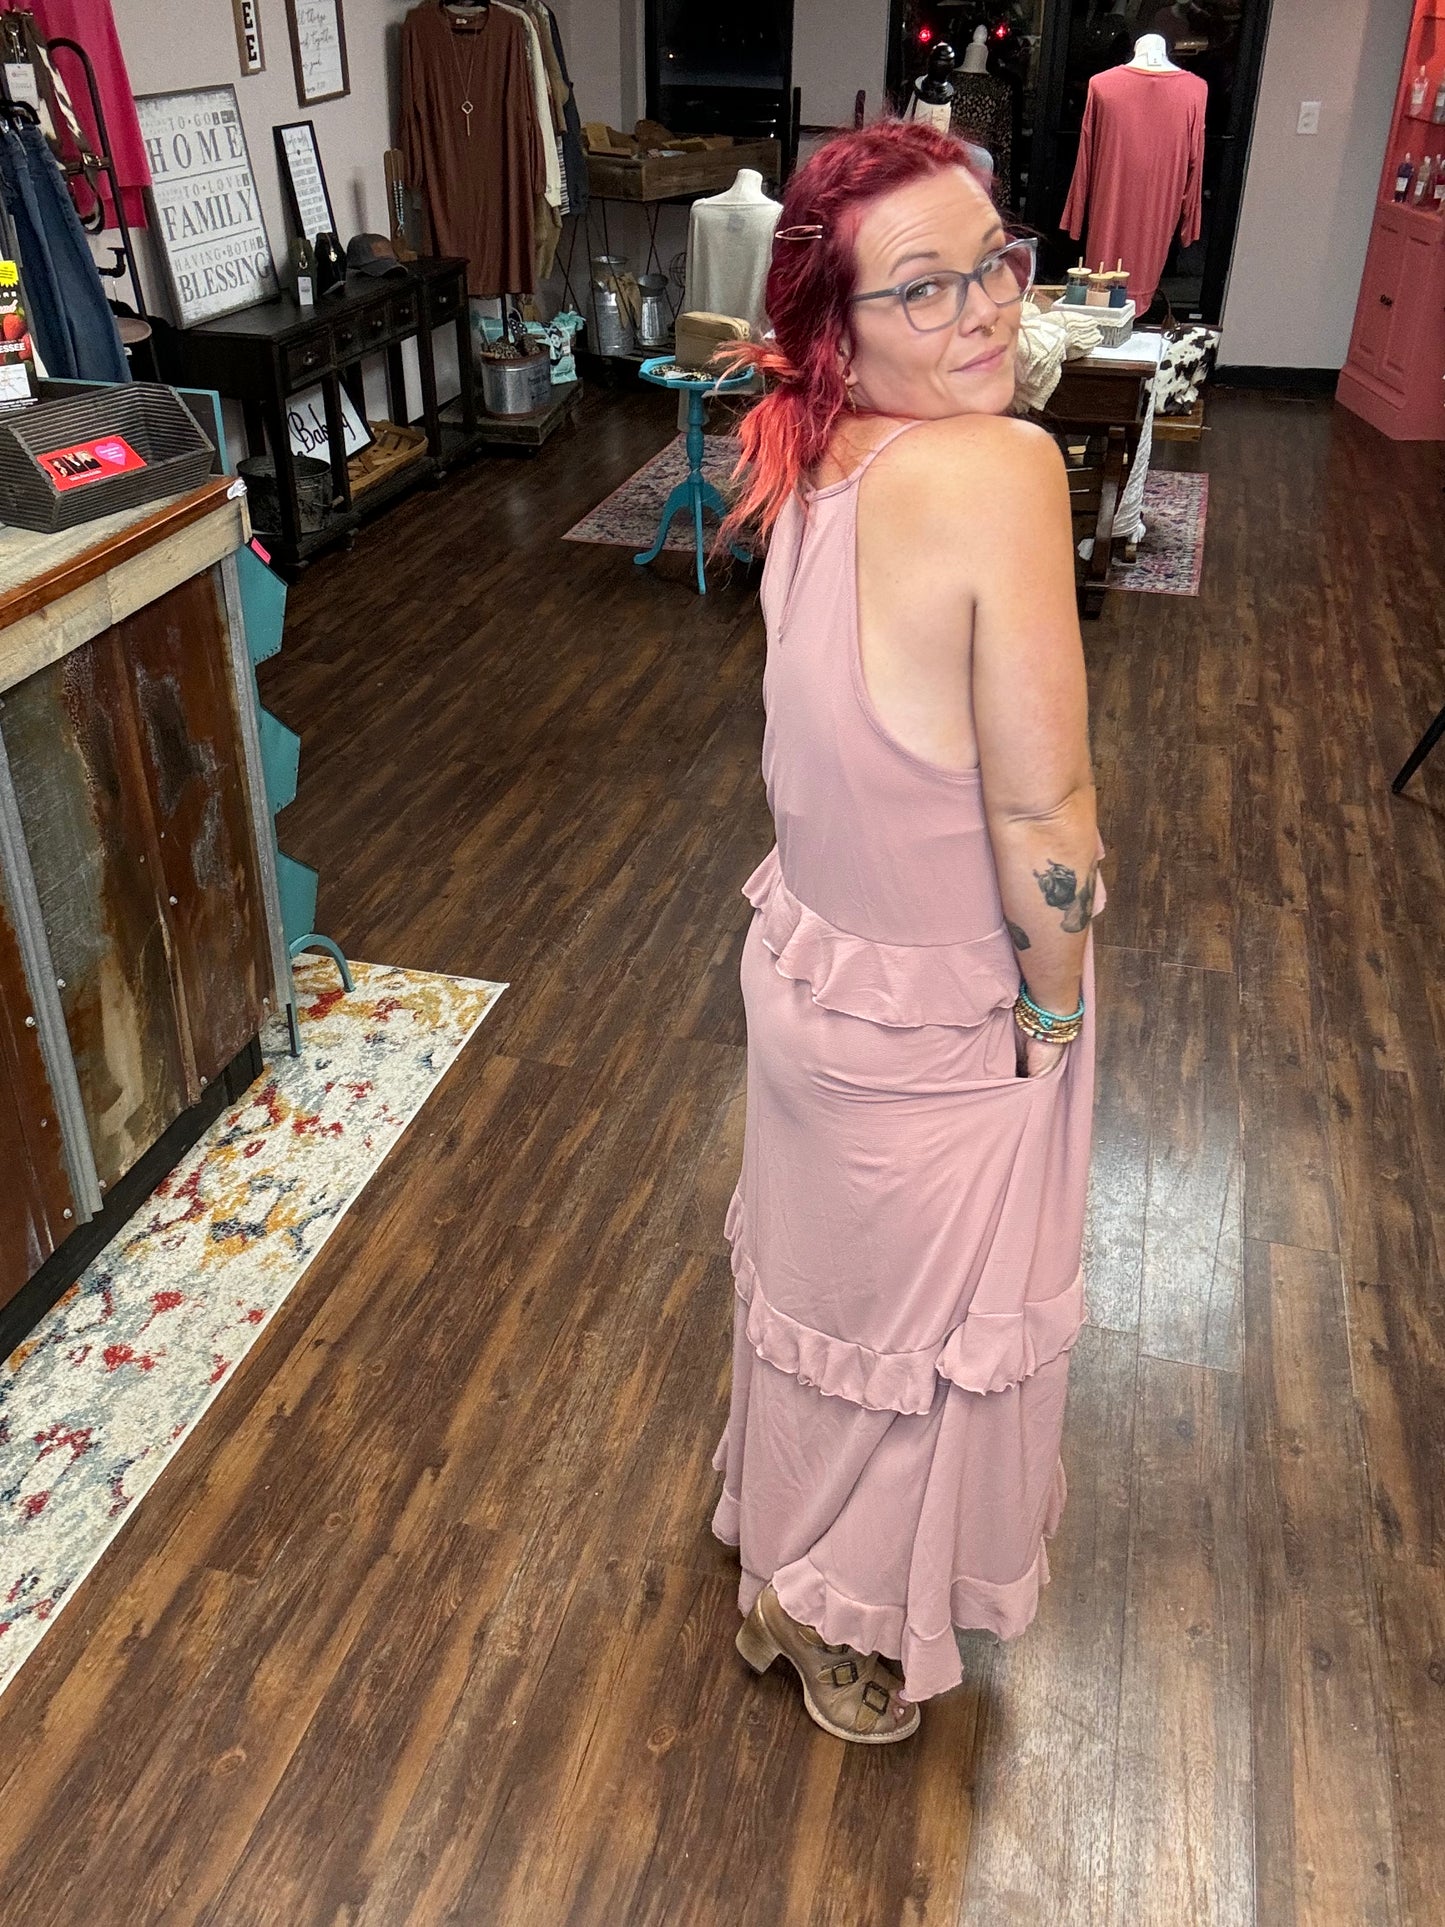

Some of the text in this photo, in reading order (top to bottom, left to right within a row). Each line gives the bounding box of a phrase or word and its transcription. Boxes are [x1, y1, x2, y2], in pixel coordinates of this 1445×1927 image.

[146, 125, 243, 174] HOME
[162, 188, 253, 242] FAMILY
[174, 248, 221, 272] HAVING
[226, 238, 257, 258] BOTH
[177, 252, 269, 303] BLESSING
